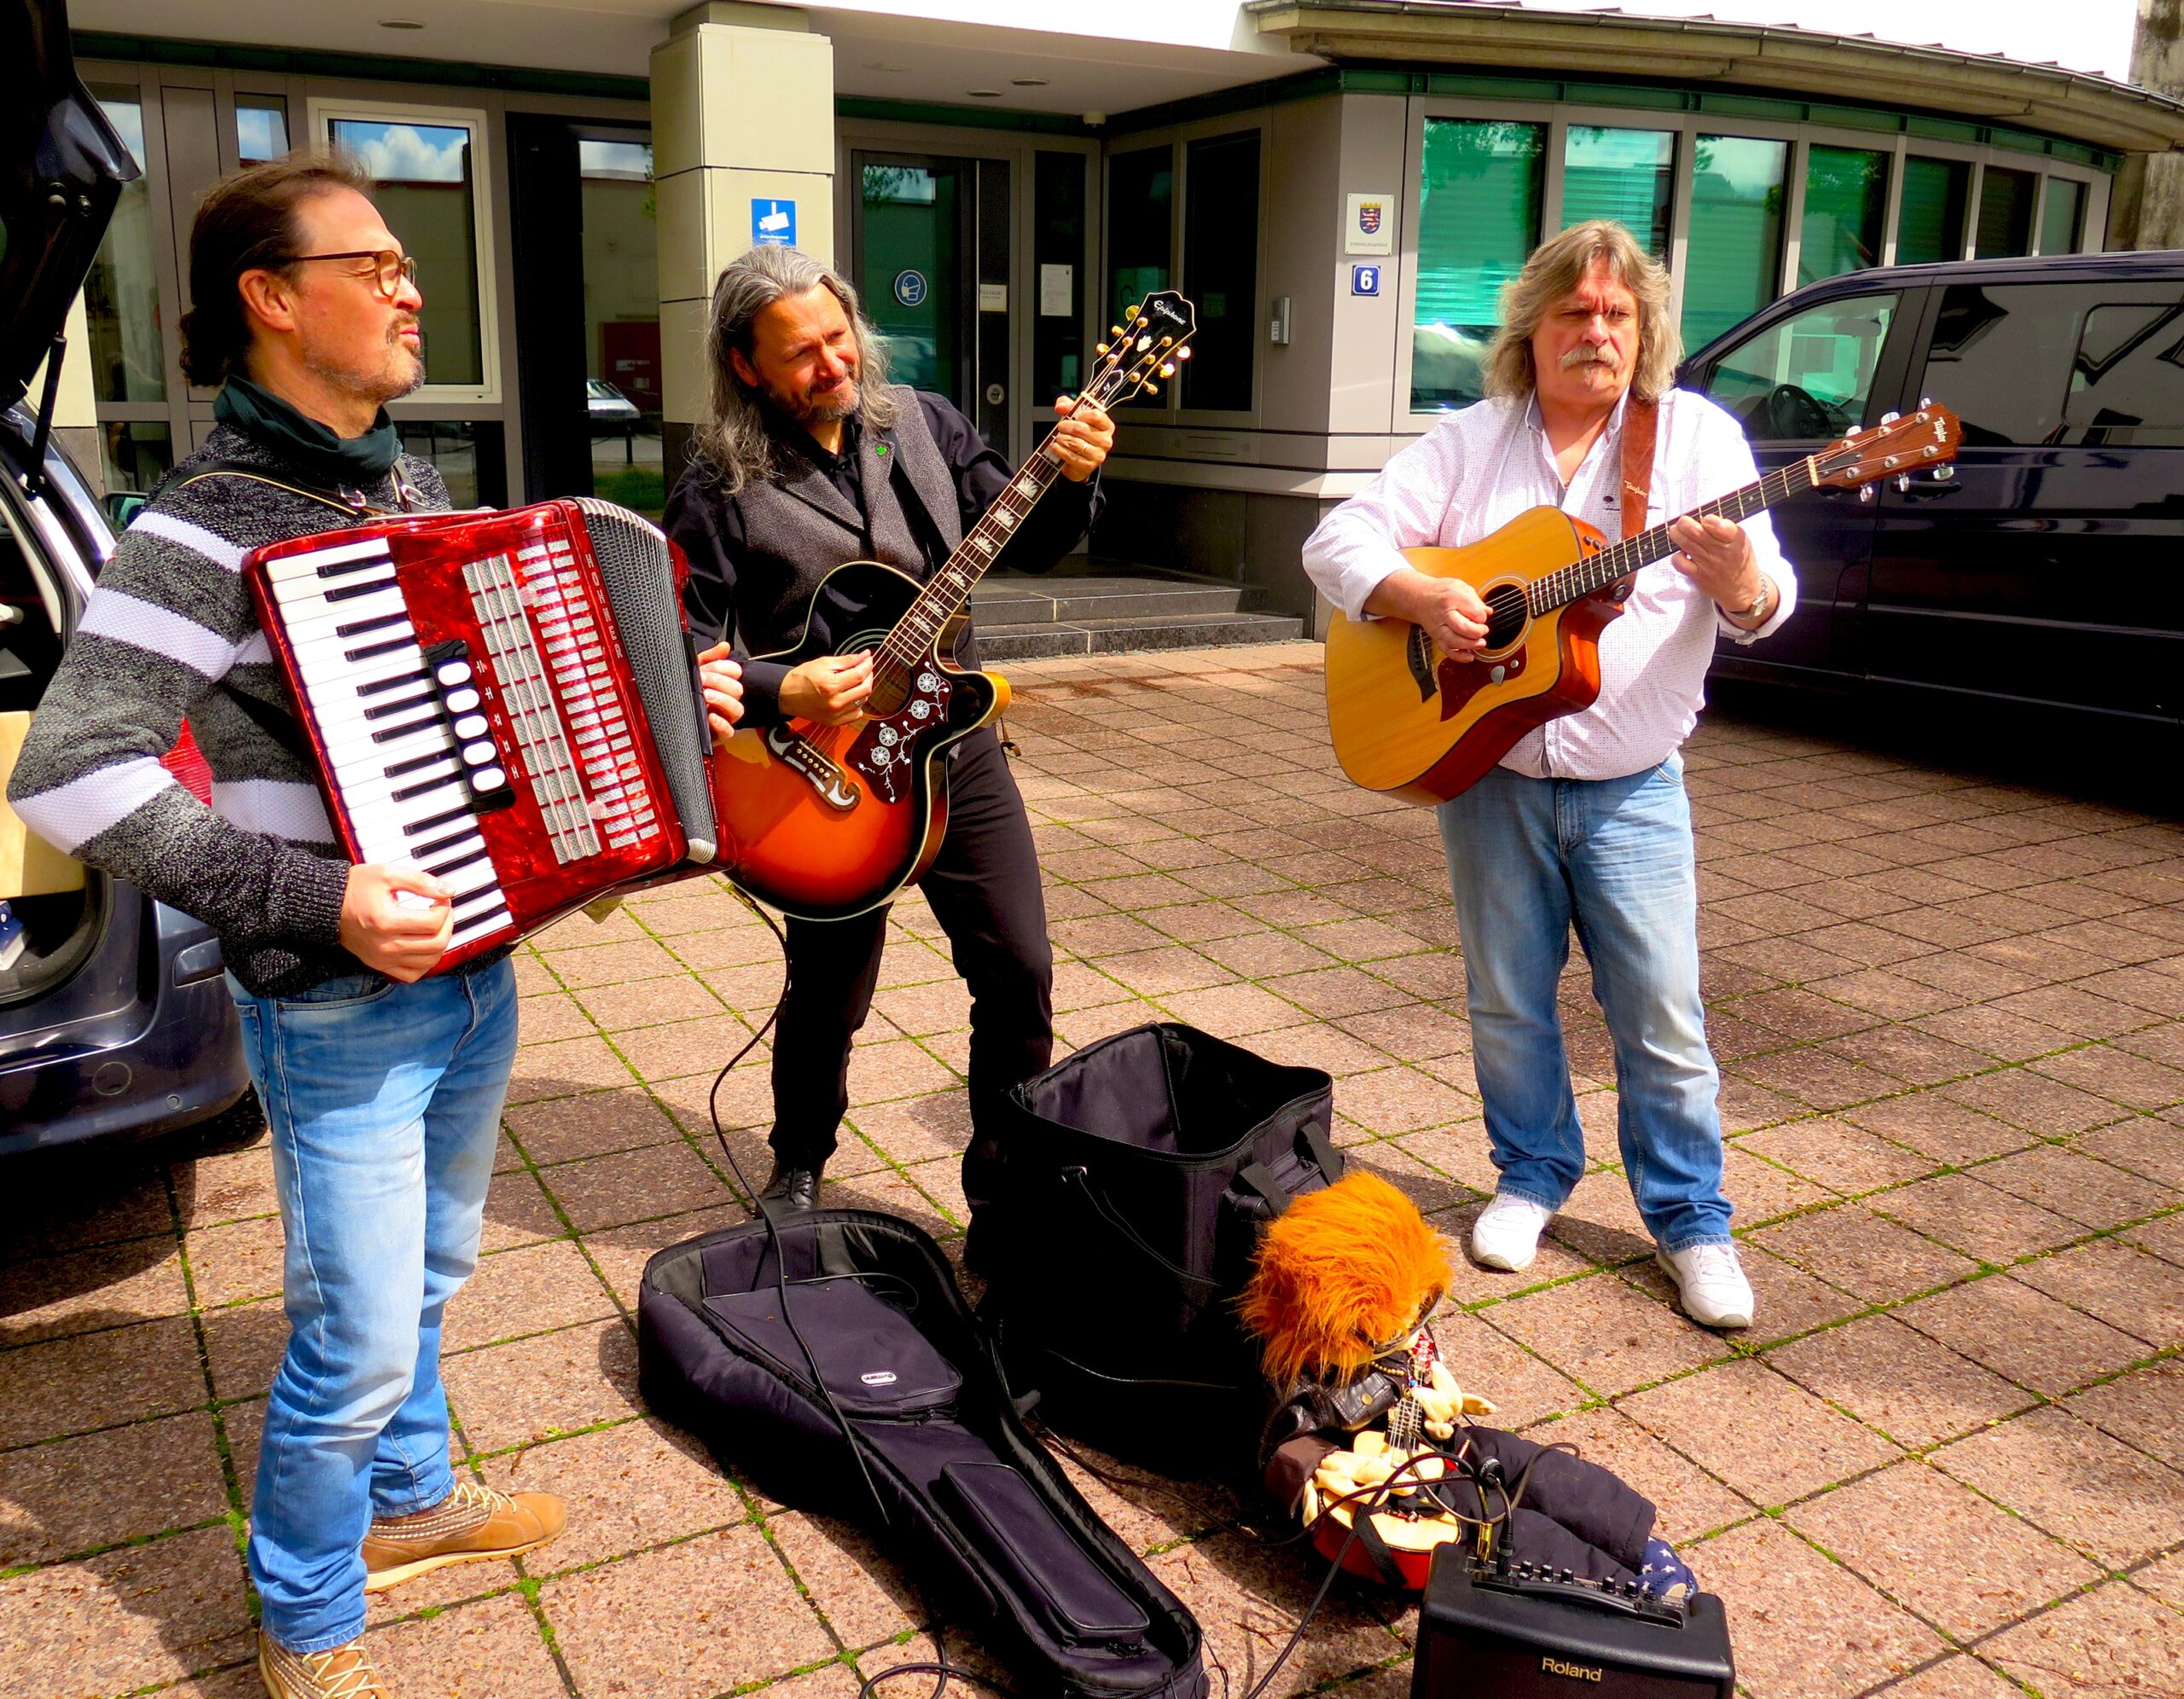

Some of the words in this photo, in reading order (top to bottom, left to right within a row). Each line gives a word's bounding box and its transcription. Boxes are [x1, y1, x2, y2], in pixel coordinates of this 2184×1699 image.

[1360, 270, 1373, 290] 6
[1153, 300, 1187, 326] Epiphone
[1933, 416, 1948, 443] Taylor
[1623, 479, 1647, 498] Taylor
[585, 553, 624, 658] HOHNER
[1542, 1656, 1602, 1682] Roland
